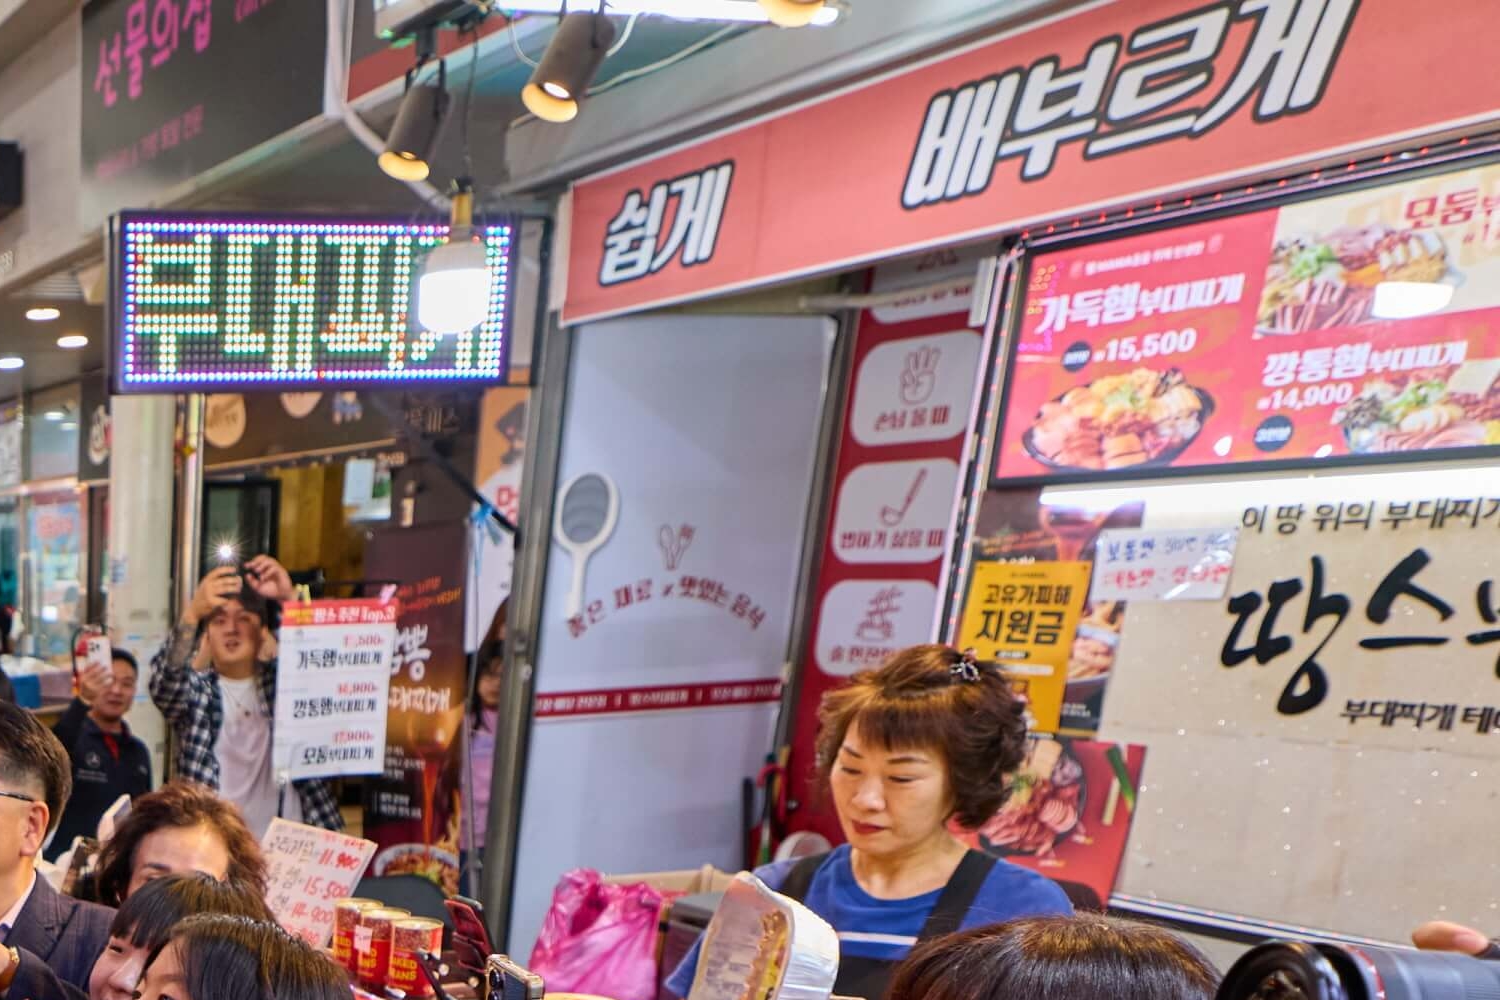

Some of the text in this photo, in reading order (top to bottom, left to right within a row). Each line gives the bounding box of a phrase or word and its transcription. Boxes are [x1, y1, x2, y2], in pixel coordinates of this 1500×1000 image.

[599, 0, 1365, 287] 쉽게 배부르게
[1034, 273, 1246, 335] 가득햄부대찌개
[1262, 341, 1468, 388] 깡통햄부대찌개
[1241, 504, 1269, 534] 이
[1276, 502, 1305, 535] 땅
[1311, 500, 1376, 532] 위의
[613, 578, 653, 610] 재료
[679, 575, 730, 608] 맛있는
[984, 584, 1073, 606] 고유가피해
[975, 609, 1065, 646] 지원금
[1340, 699, 1500, 734] 부대찌개 테
